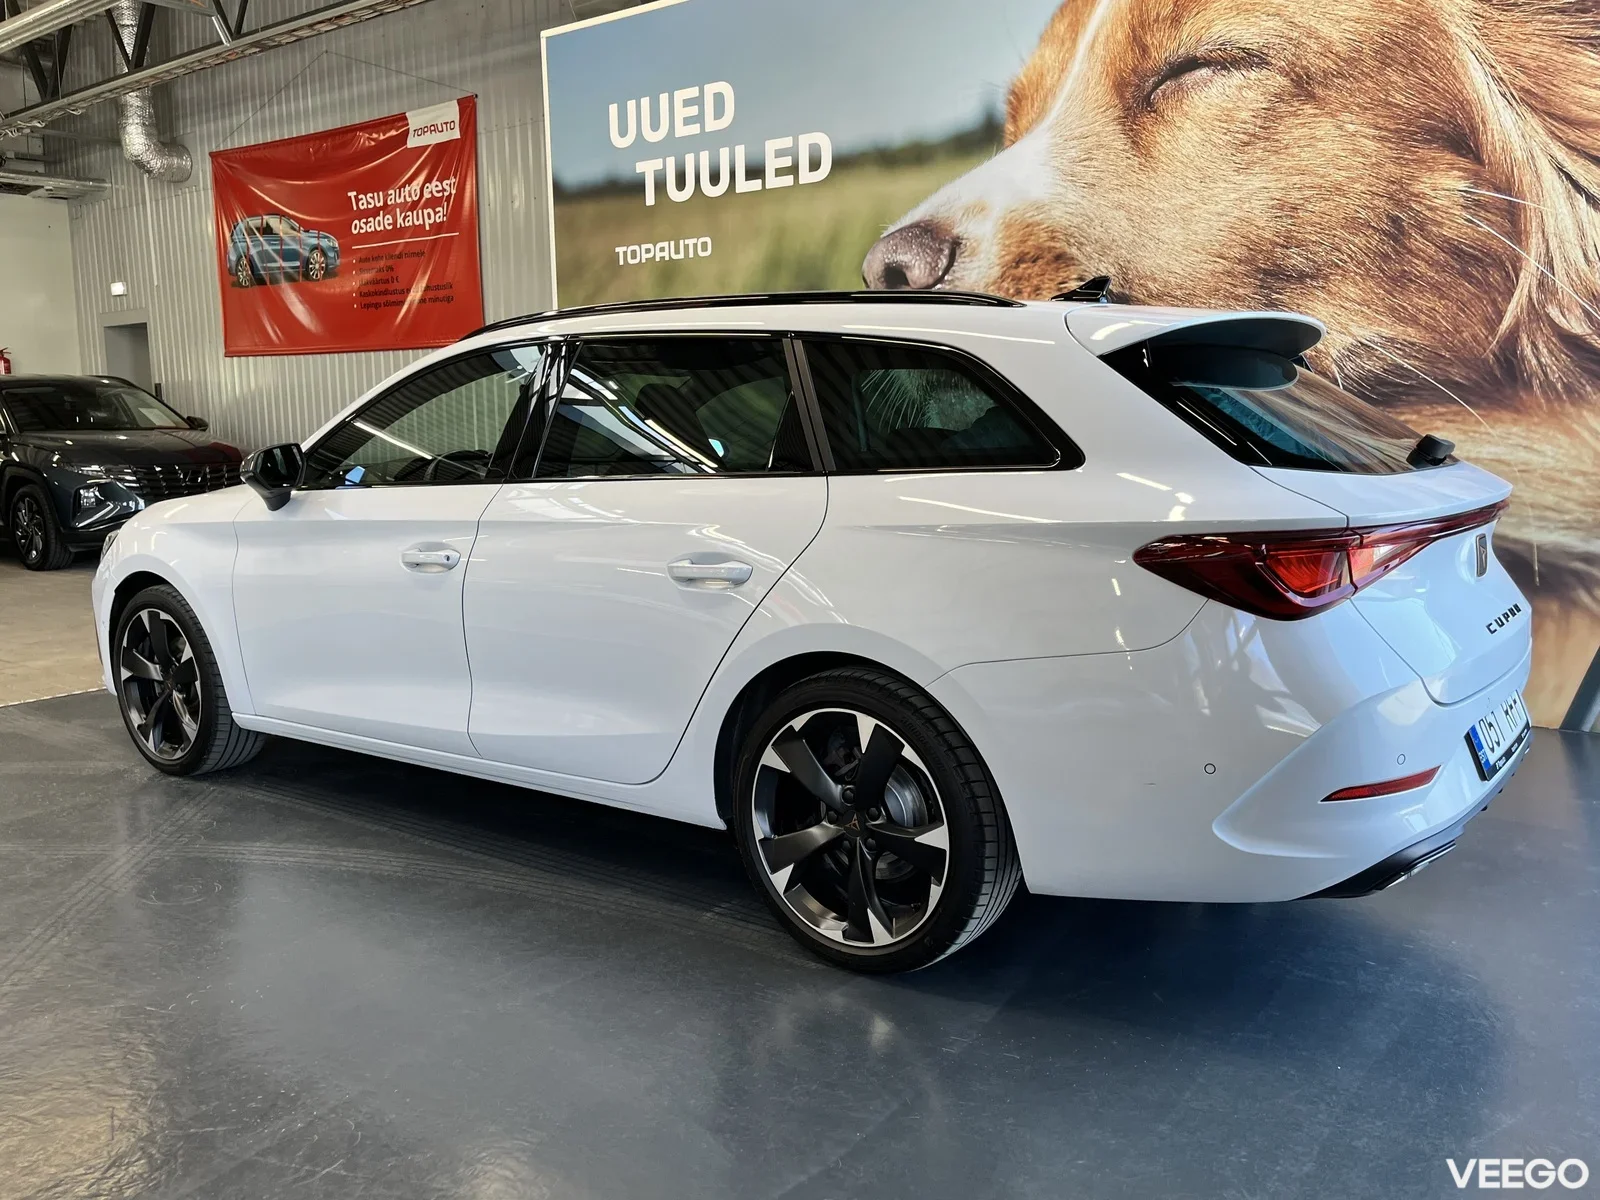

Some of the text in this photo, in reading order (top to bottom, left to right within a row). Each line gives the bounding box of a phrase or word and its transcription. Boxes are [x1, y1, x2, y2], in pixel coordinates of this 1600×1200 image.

[412, 120, 456, 138] TOPAUTO
[608, 81, 735, 149] UUED
[635, 131, 833, 207] TUULED
[347, 176, 457, 211] Tasu auto eest
[351, 202, 448, 235] osade kaupa!
[614, 236, 712, 266] TOPAUTO
[1478, 710, 1506, 754] 051
